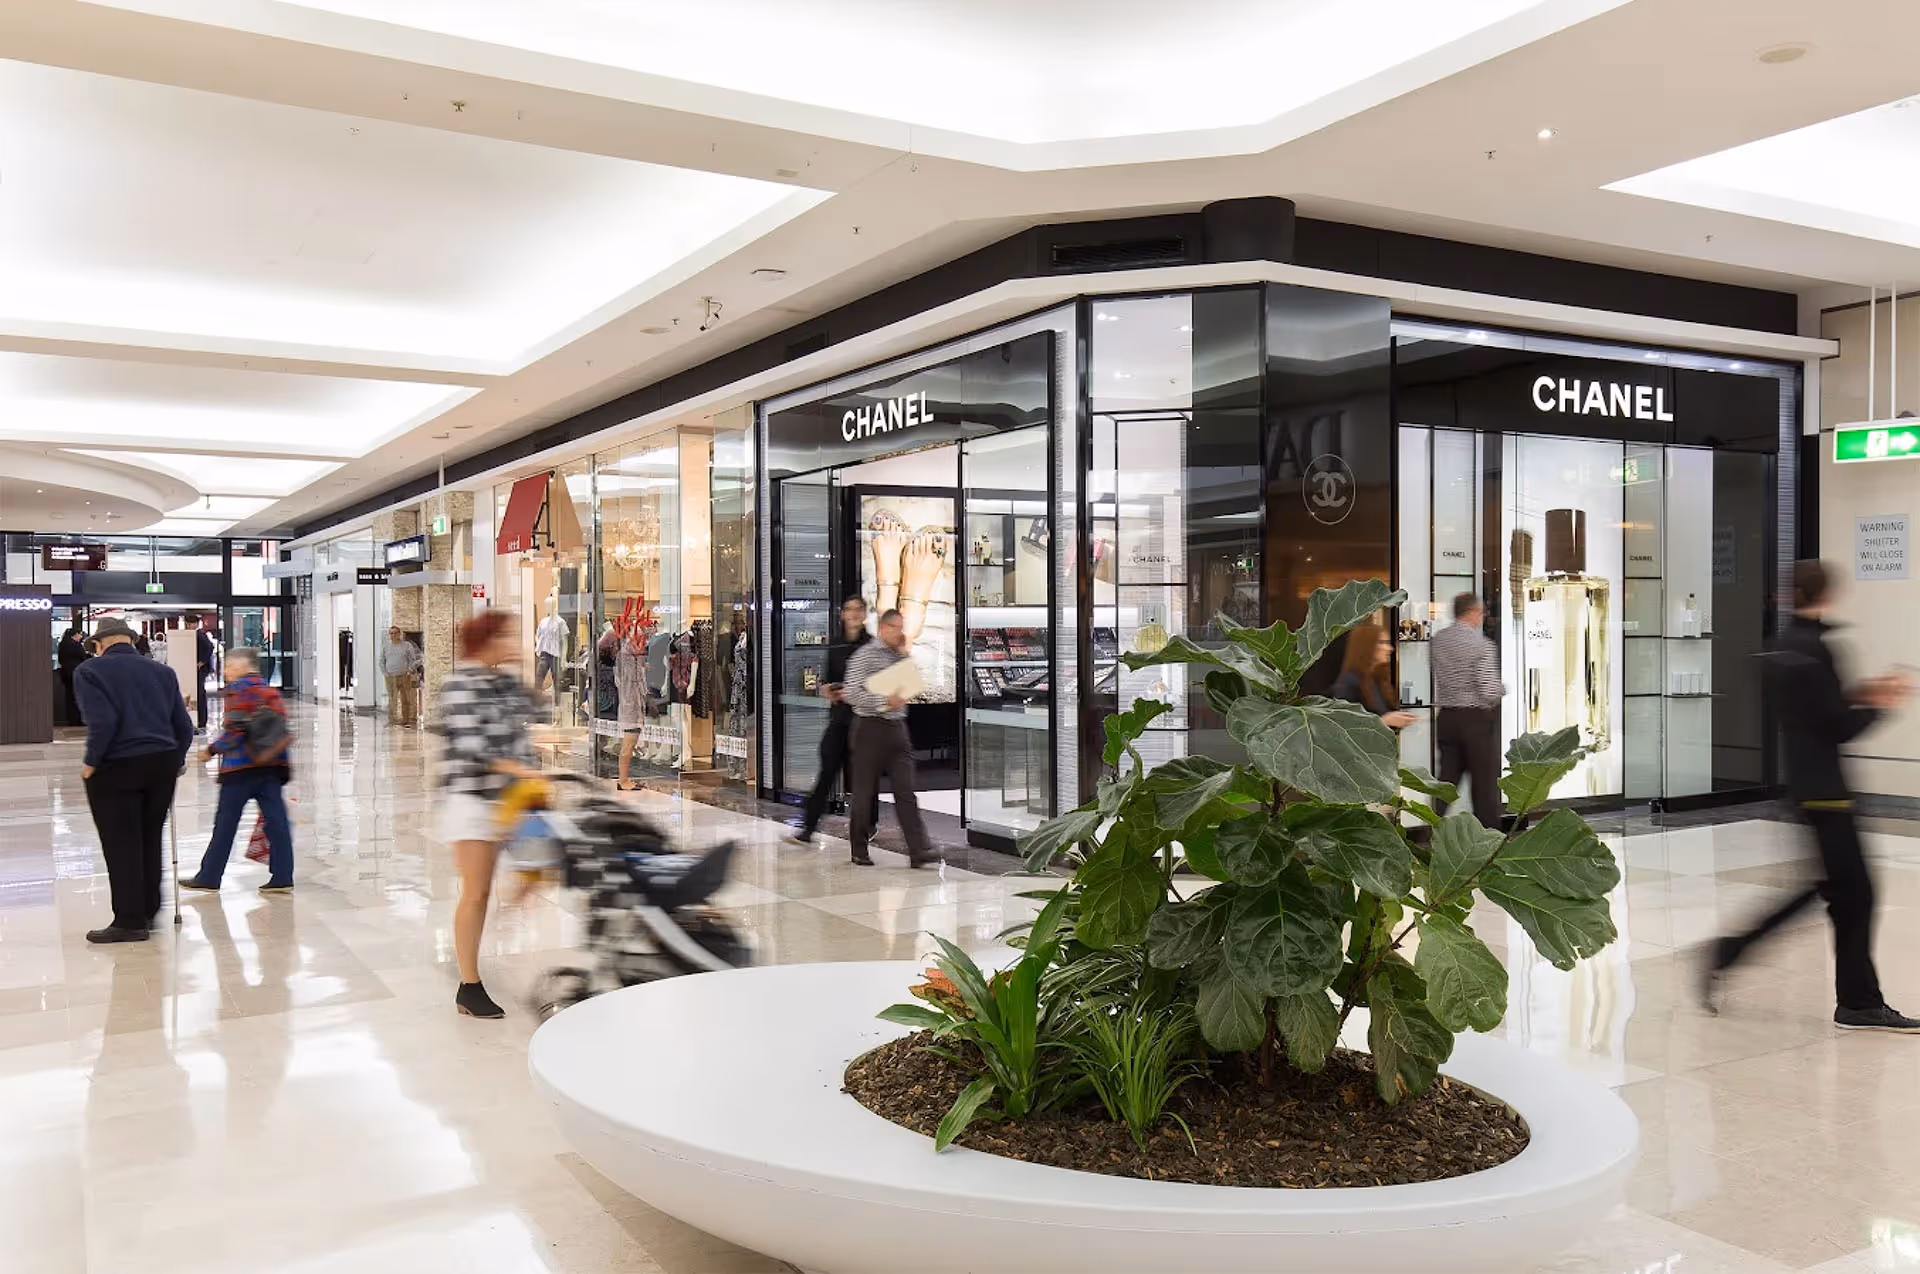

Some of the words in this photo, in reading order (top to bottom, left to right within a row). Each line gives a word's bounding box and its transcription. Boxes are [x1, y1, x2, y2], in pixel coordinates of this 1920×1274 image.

[1532, 375, 1674, 422] CHANEL
[842, 390, 934, 442] CHANEL
[1860, 521, 1904, 533] WARNING
[1864, 537, 1900, 547] SHUTTER
[1880, 550, 1904, 559] CLOSE
[1875, 562, 1903, 571] ALARM
